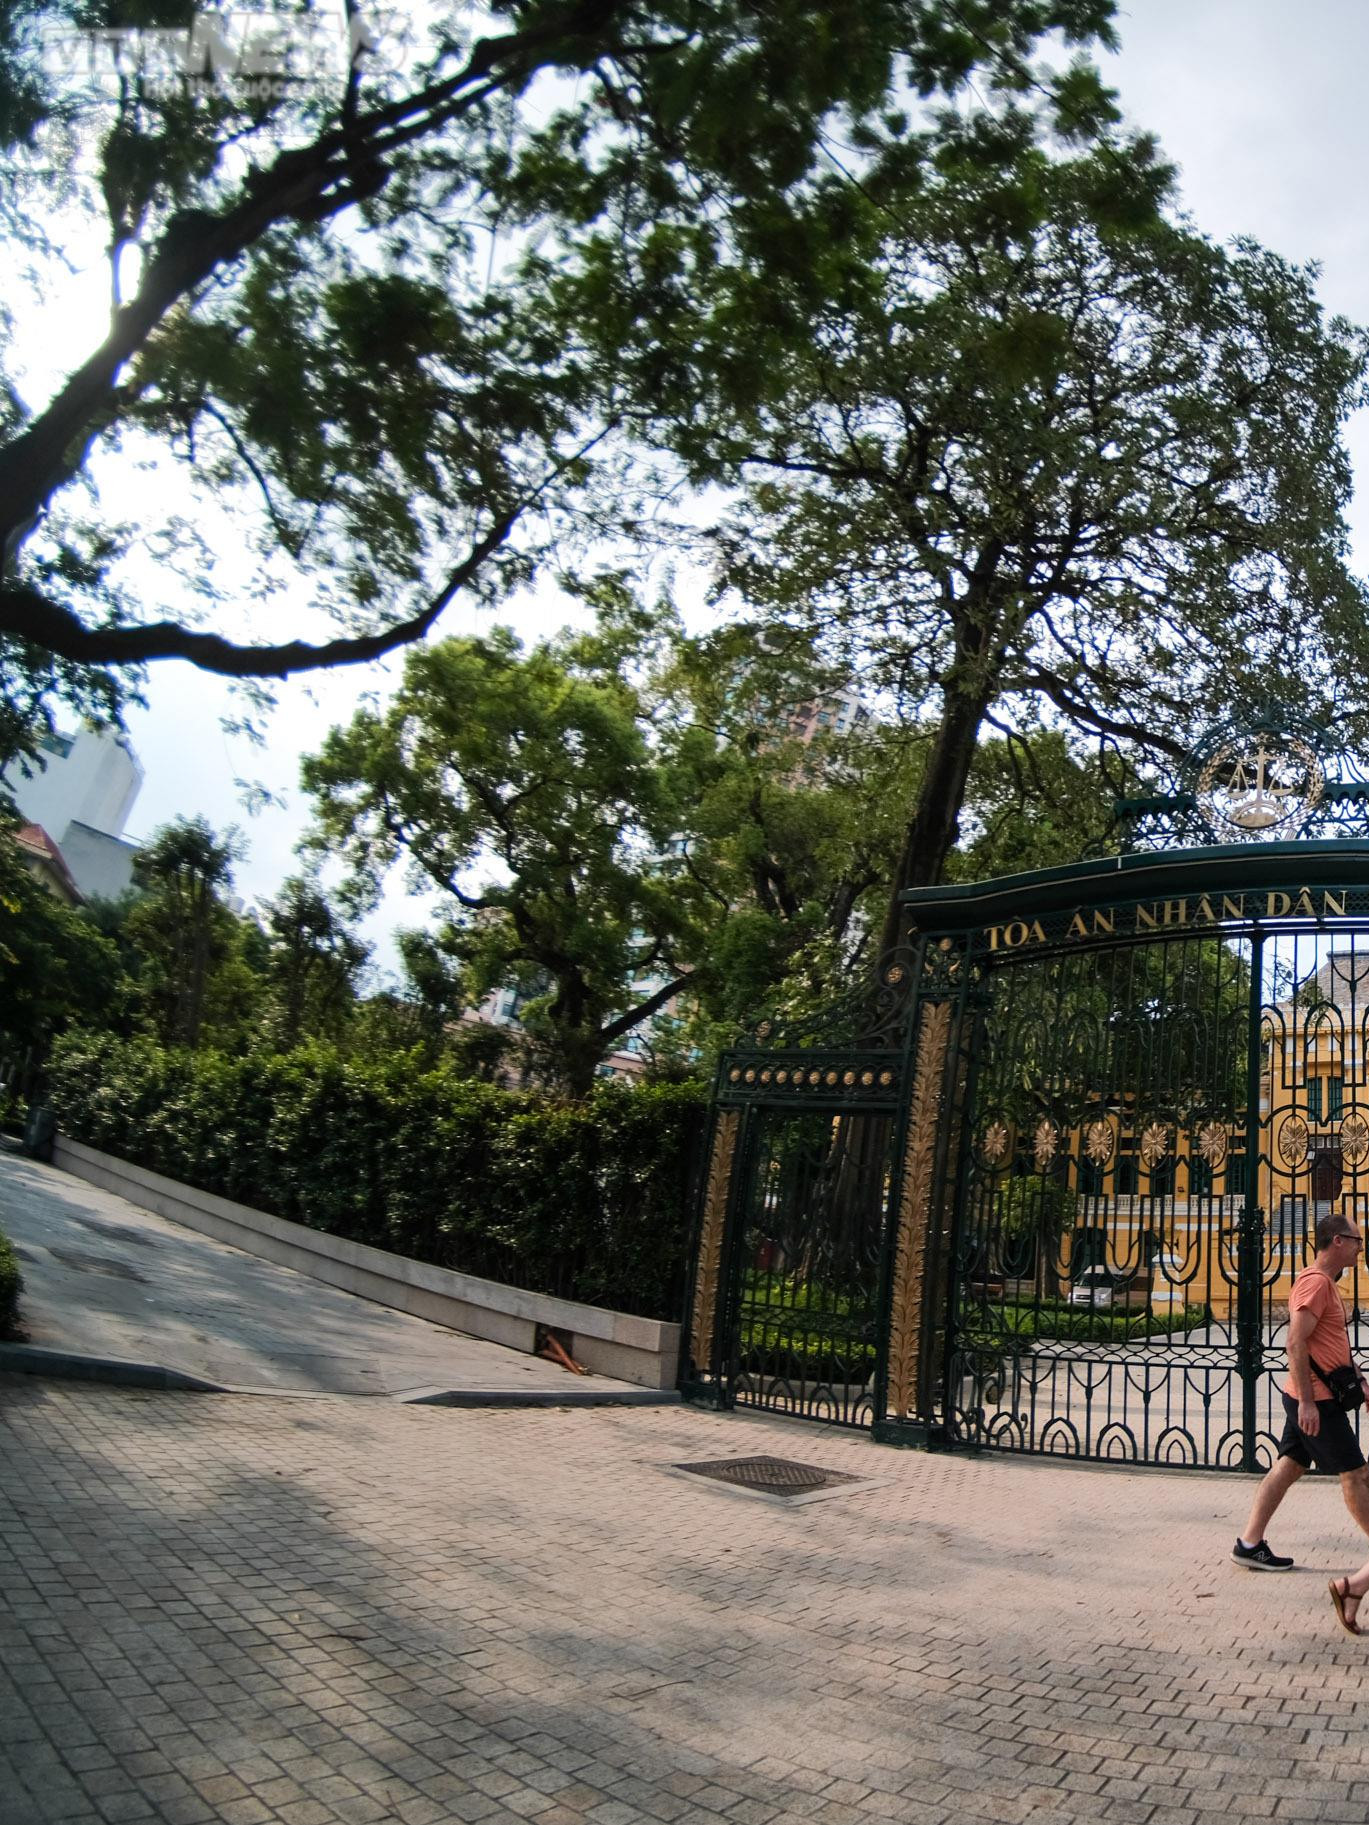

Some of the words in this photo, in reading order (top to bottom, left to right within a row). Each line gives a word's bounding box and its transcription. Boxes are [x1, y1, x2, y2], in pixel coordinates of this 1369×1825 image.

[1064, 905, 1116, 937] ÁN
[1135, 892, 1246, 931] NHÂN
[1266, 886, 1348, 917] DÂN
